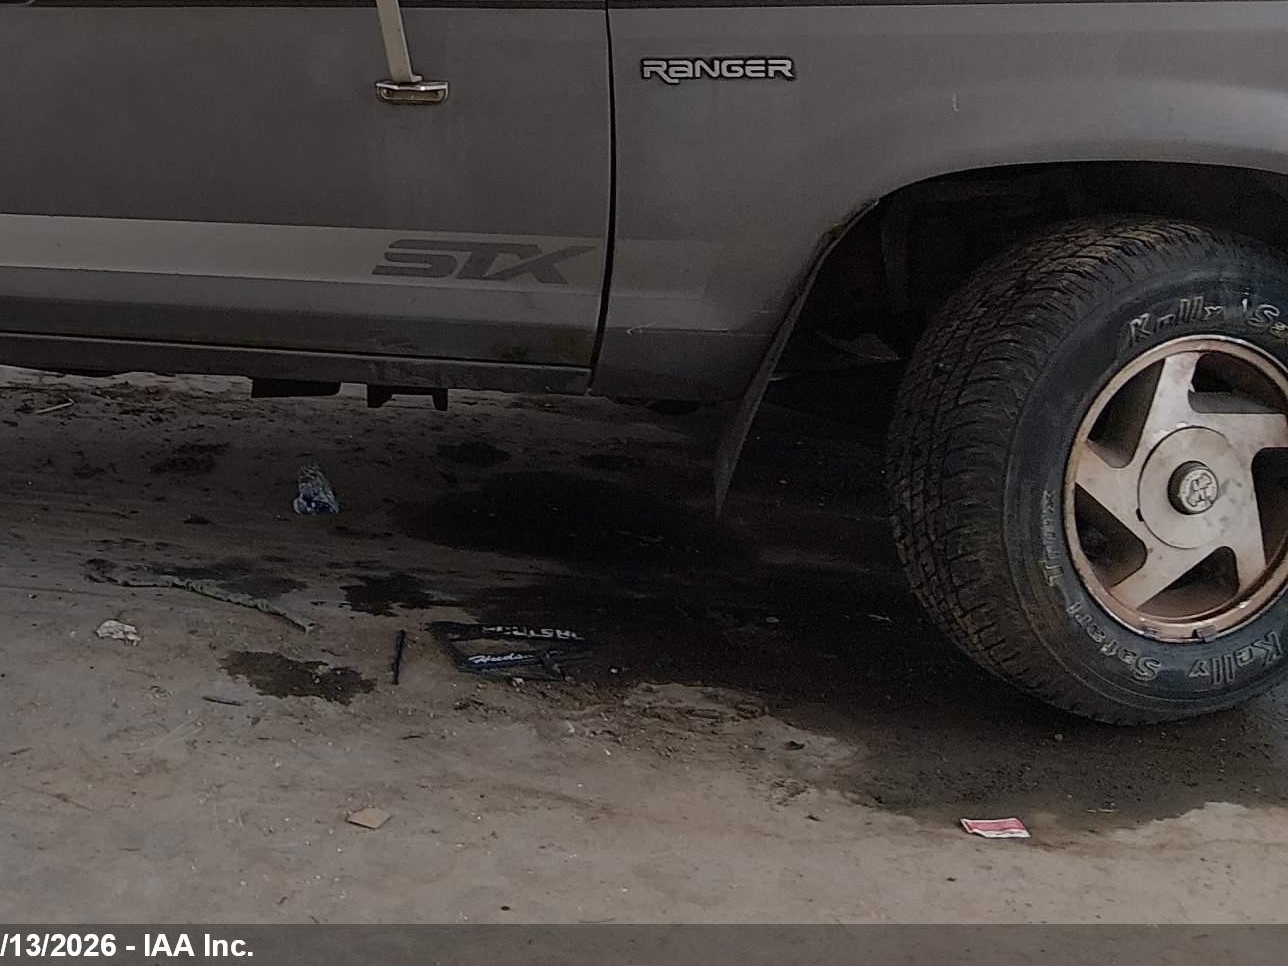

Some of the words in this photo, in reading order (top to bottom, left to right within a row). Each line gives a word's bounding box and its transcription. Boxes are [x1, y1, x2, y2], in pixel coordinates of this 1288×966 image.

[641, 56, 796, 85] RANGER
[371, 239, 599, 285] STX
[1065, 600, 1162, 682] Safari
[1186, 630, 1284, 687] Kelly
